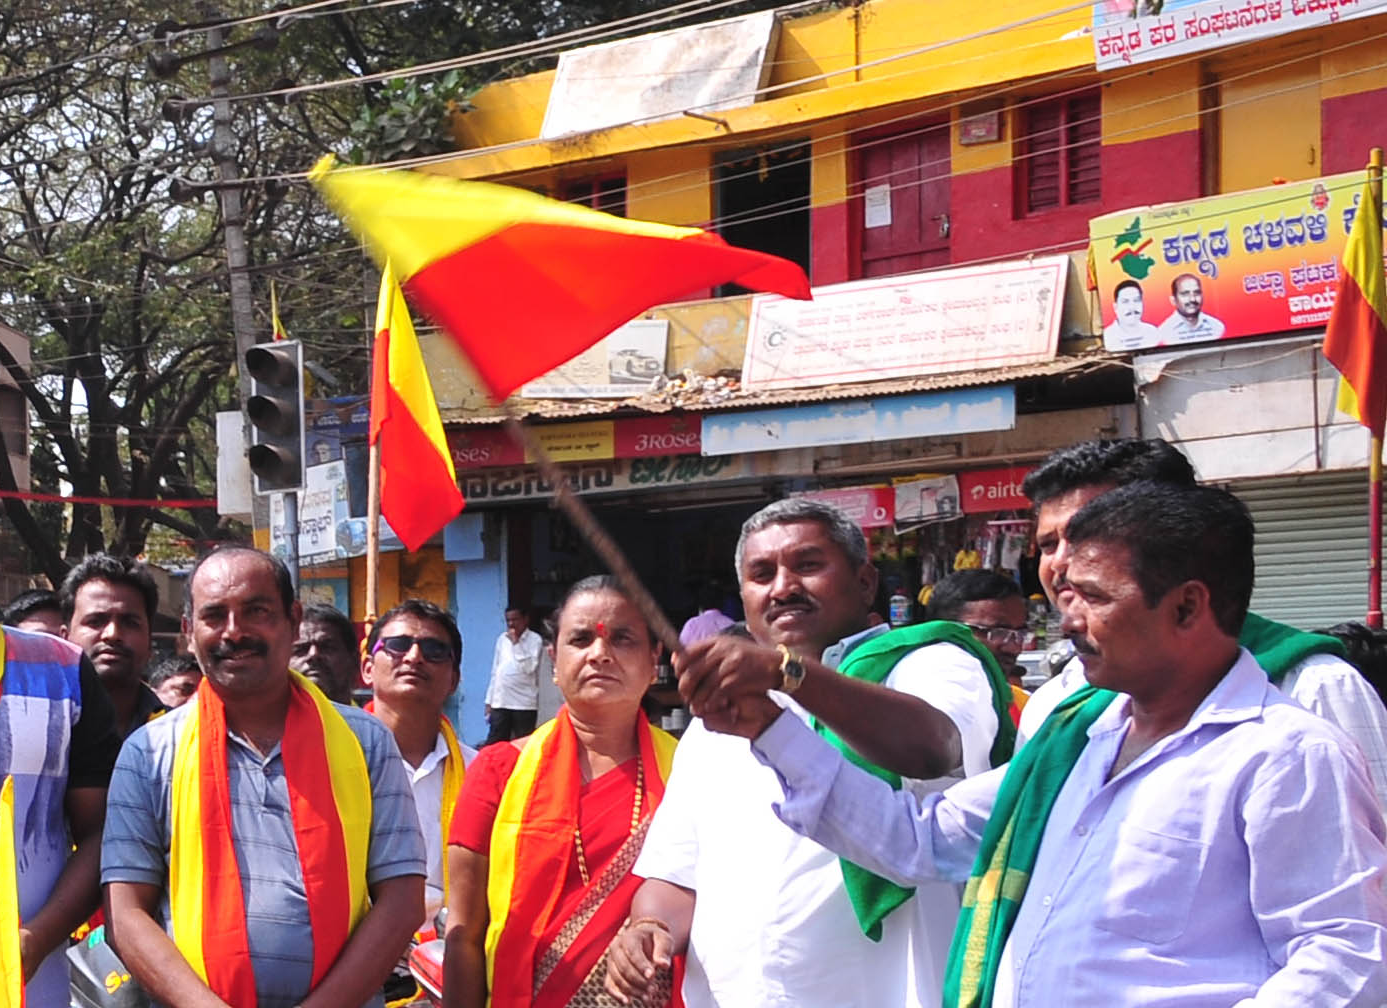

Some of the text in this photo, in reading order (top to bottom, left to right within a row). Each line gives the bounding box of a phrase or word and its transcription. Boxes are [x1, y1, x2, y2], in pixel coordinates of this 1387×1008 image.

[1099, 28, 1142, 63] ಕನ್ನಡ
[1149, 17, 1177, 46] ಪರ
[1162, 222, 1230, 279] ಕನ್ನಡ
[1242, 208, 1328, 254] ಚಳವಳಿ
